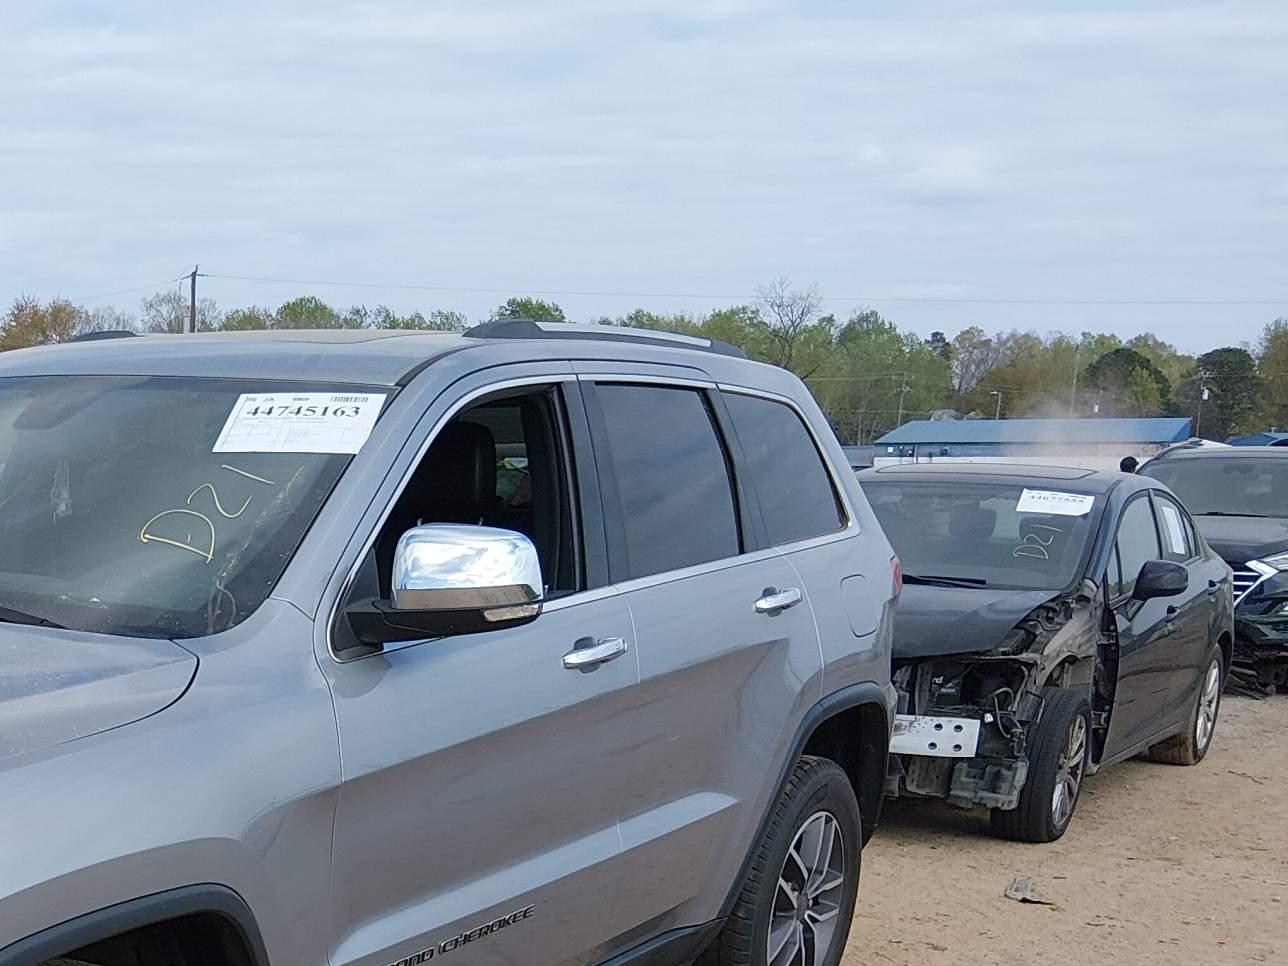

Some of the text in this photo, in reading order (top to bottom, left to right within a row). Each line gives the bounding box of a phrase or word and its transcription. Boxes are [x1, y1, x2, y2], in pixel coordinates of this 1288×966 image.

[246, 405, 361, 418] 44745163
[138, 464, 276, 564] D21
[1012, 524, 1064, 560] D21
[438, 903, 537, 955] CHEROKEE
